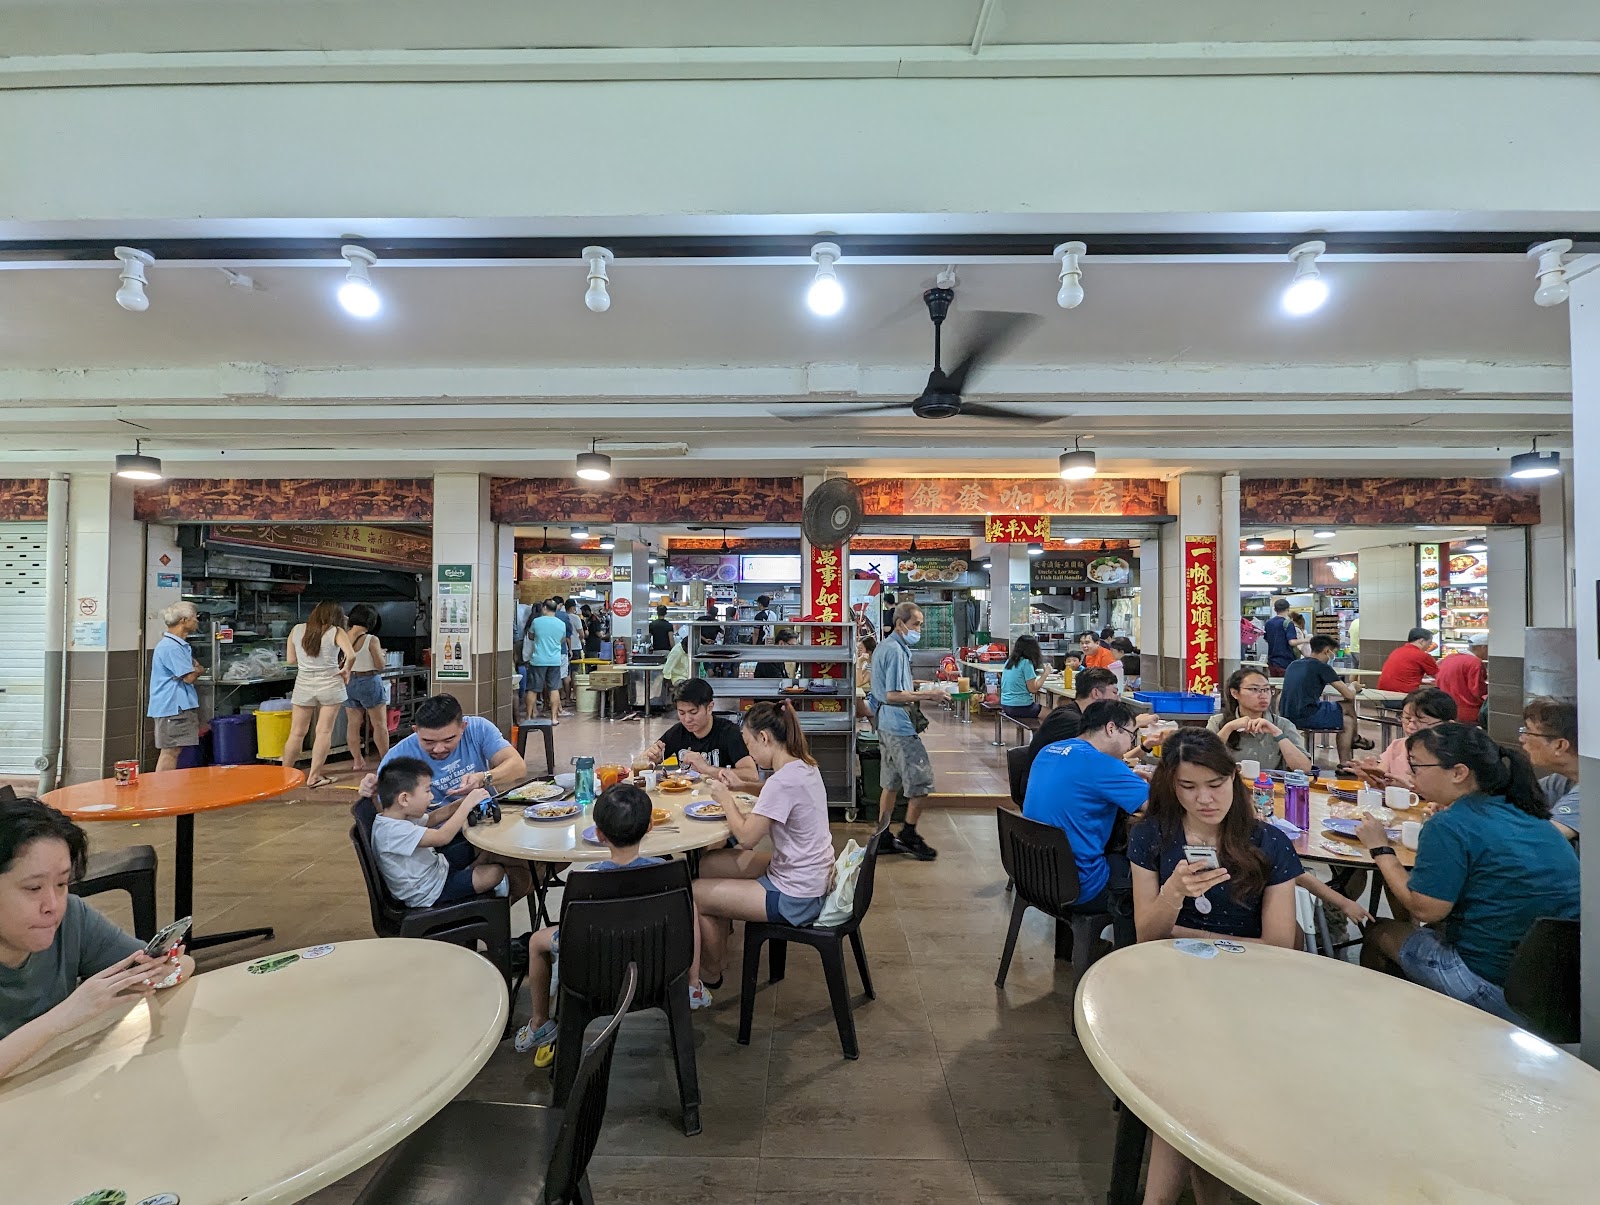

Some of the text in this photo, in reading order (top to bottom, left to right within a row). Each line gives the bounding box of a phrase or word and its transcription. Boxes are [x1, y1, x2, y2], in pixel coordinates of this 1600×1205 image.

[910, 482, 1117, 513] 錦發咖啡店
[444, 569, 465, 578] Carlsberg
[1190, 547, 1214, 697] 一帆風順年年好
[453, 769, 466, 777] EASY
[466, 763, 475, 771] DAY
